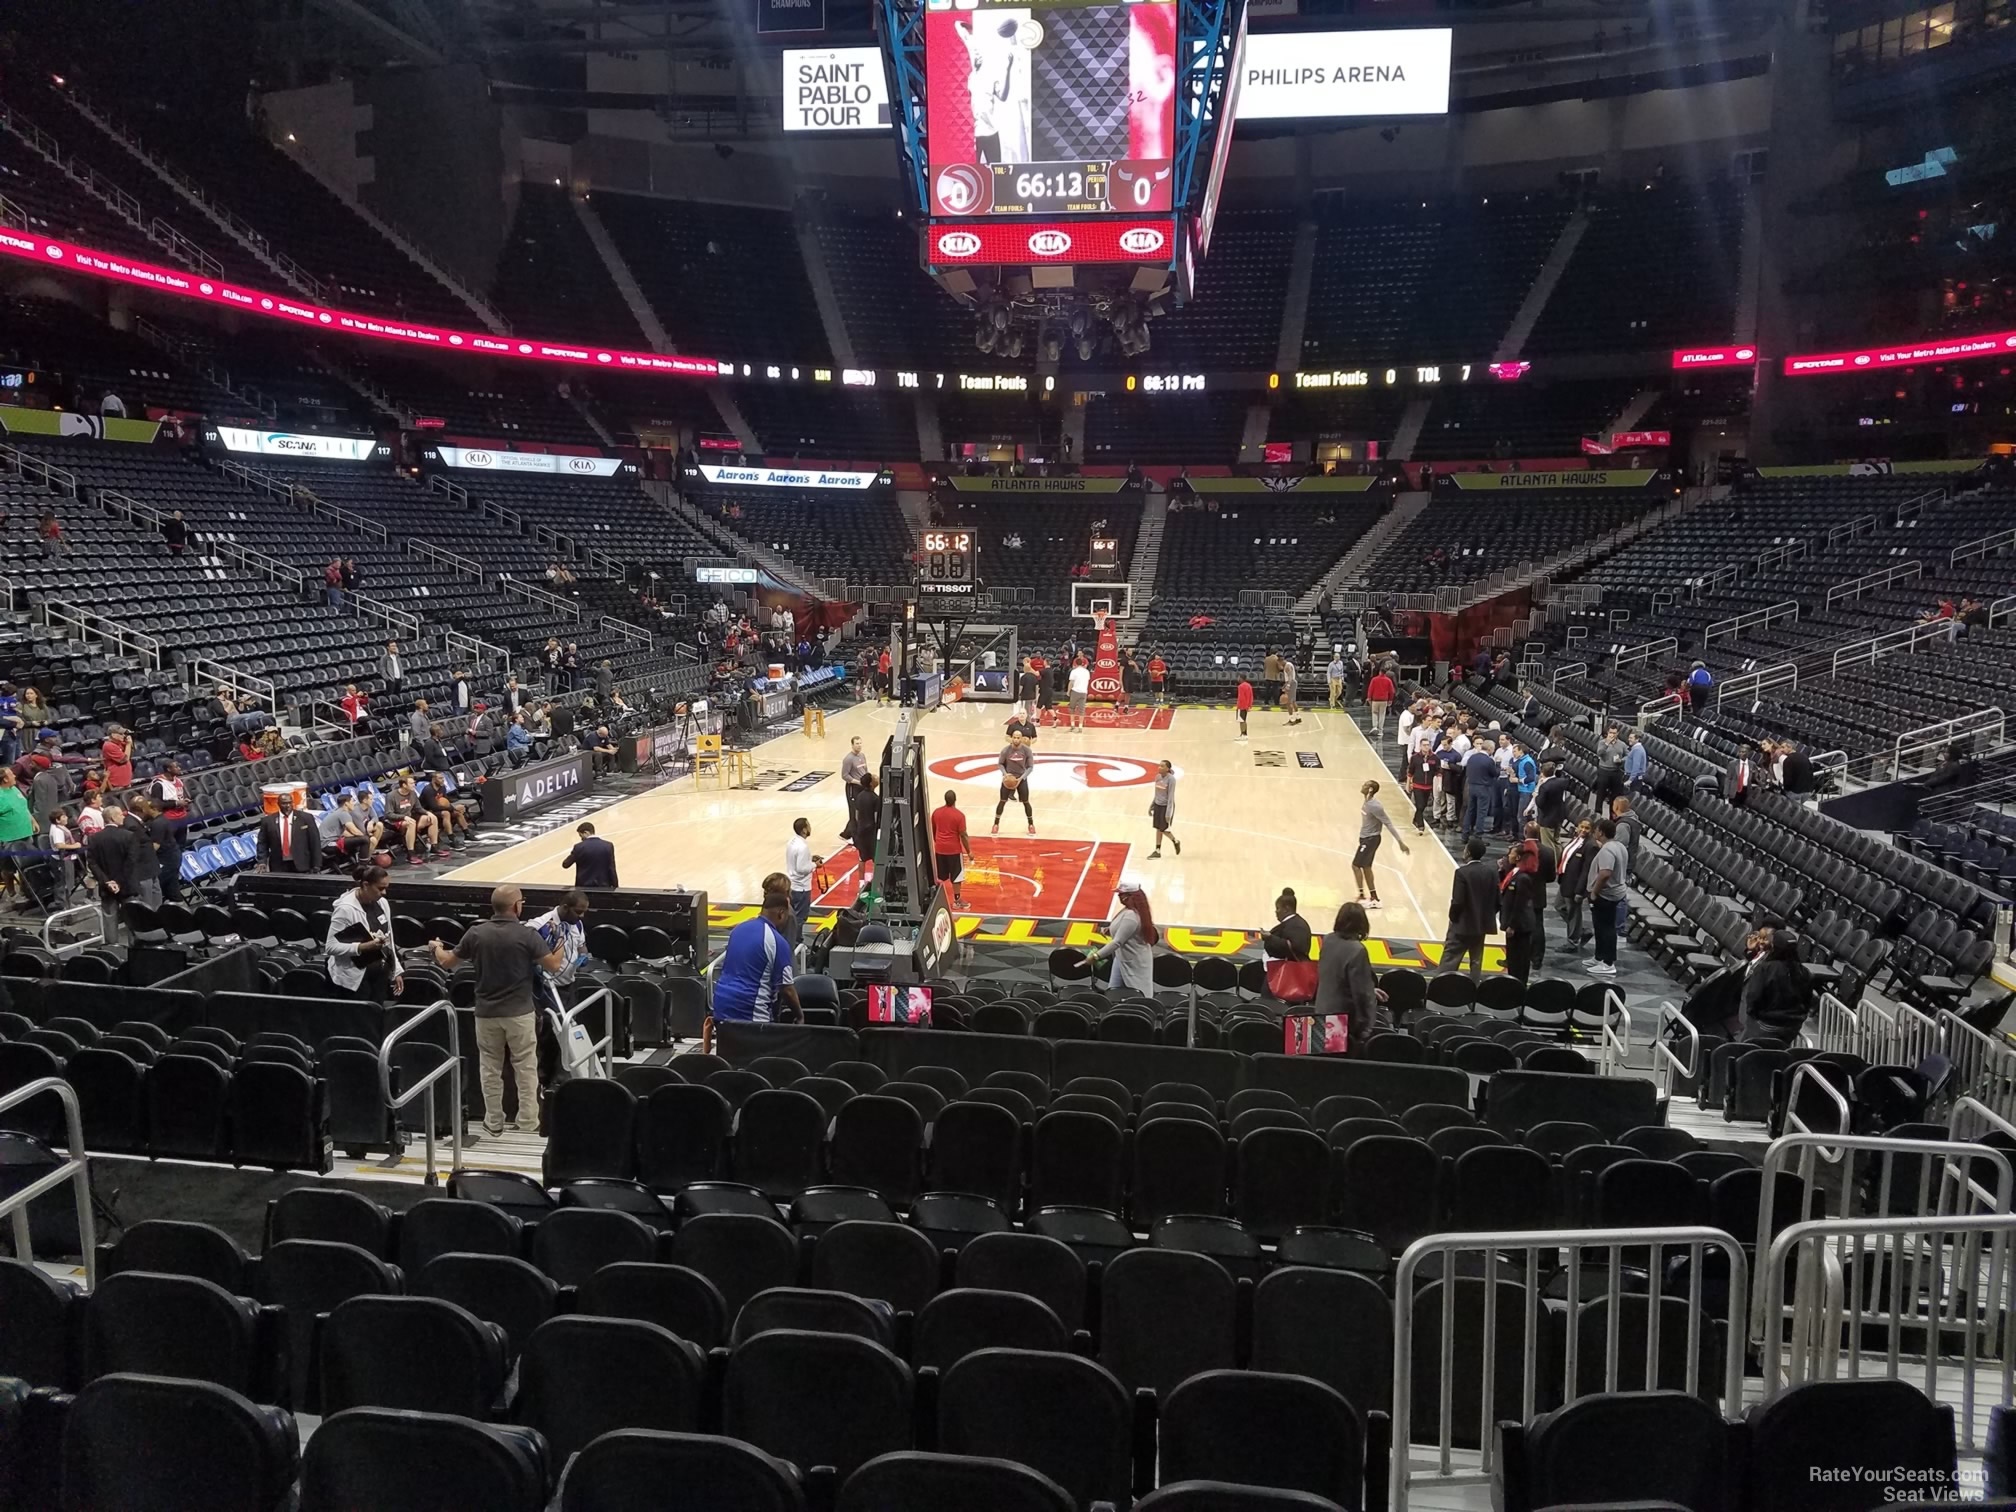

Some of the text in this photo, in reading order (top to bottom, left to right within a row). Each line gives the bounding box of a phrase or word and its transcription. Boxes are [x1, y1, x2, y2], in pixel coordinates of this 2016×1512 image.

[799, 64, 864, 84] SAINT
[1249, 65, 1406, 85] PHILIPS ARENA
[799, 85, 871, 105] PABLO
[800, 107, 861, 126] TOUR
[951, 182, 967, 209] 0
[1134, 178, 1151, 205] 0
[75, 253, 92, 267] Visit
[93, 258, 108, 270] Your
[110, 262, 130, 275] Metro
[166, 276, 189, 289] Dealers
[897, 372, 944, 389] TOL 7
[959, 374, 992, 390] Team
[995, 375, 1027, 390] Fouls
[1295, 373, 1330, 388] Team
[1332, 371, 1368, 386] Fouls
[1417, 366, 1471, 383] TOL 7
[205, 432, 217, 441] 117
[278, 440, 317, 451] SCANA
[378, 447, 391, 455] 117
[624, 465, 636, 473] 118
[716, 469, 861, 486] Aaron's Aaron's Aaron's
[878, 477, 891, 485] 119
[991, 479, 1086, 490] ATLANTA HAWKS
[1500, 473, 1607, 486] ATLANTA HAWKS
[925, 534, 969, 551] 66:12
[936, 585, 973, 593] TISSOT
[766, 699, 787, 716] DELTA
[536, 768, 578, 797] DELTA
